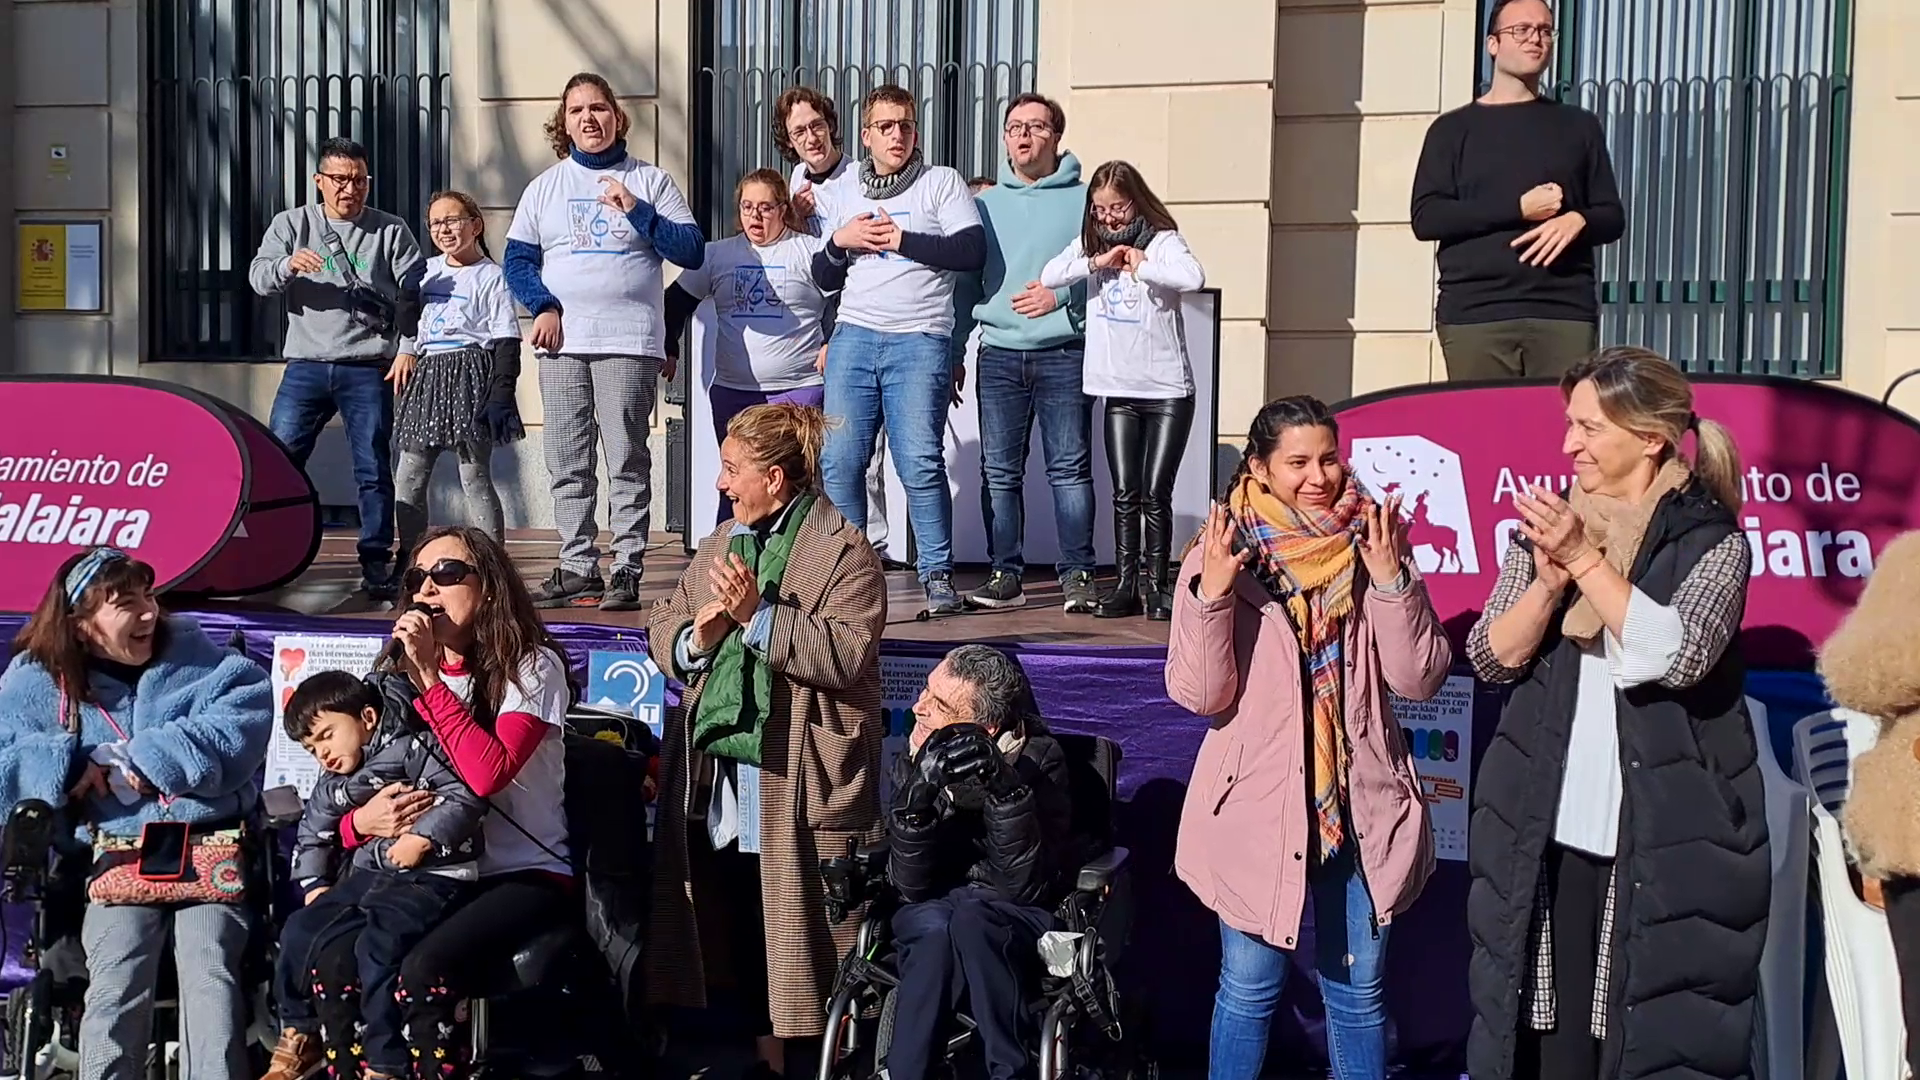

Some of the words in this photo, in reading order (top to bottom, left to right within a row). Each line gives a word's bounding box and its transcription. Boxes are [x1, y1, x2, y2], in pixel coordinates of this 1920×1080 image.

[127, 454, 169, 487] de
[1806, 462, 1862, 503] de
[0, 493, 150, 549] alajara
[643, 705, 657, 722] T
[1449, 706, 1463, 715] del
[1452, 699, 1469, 707] con
